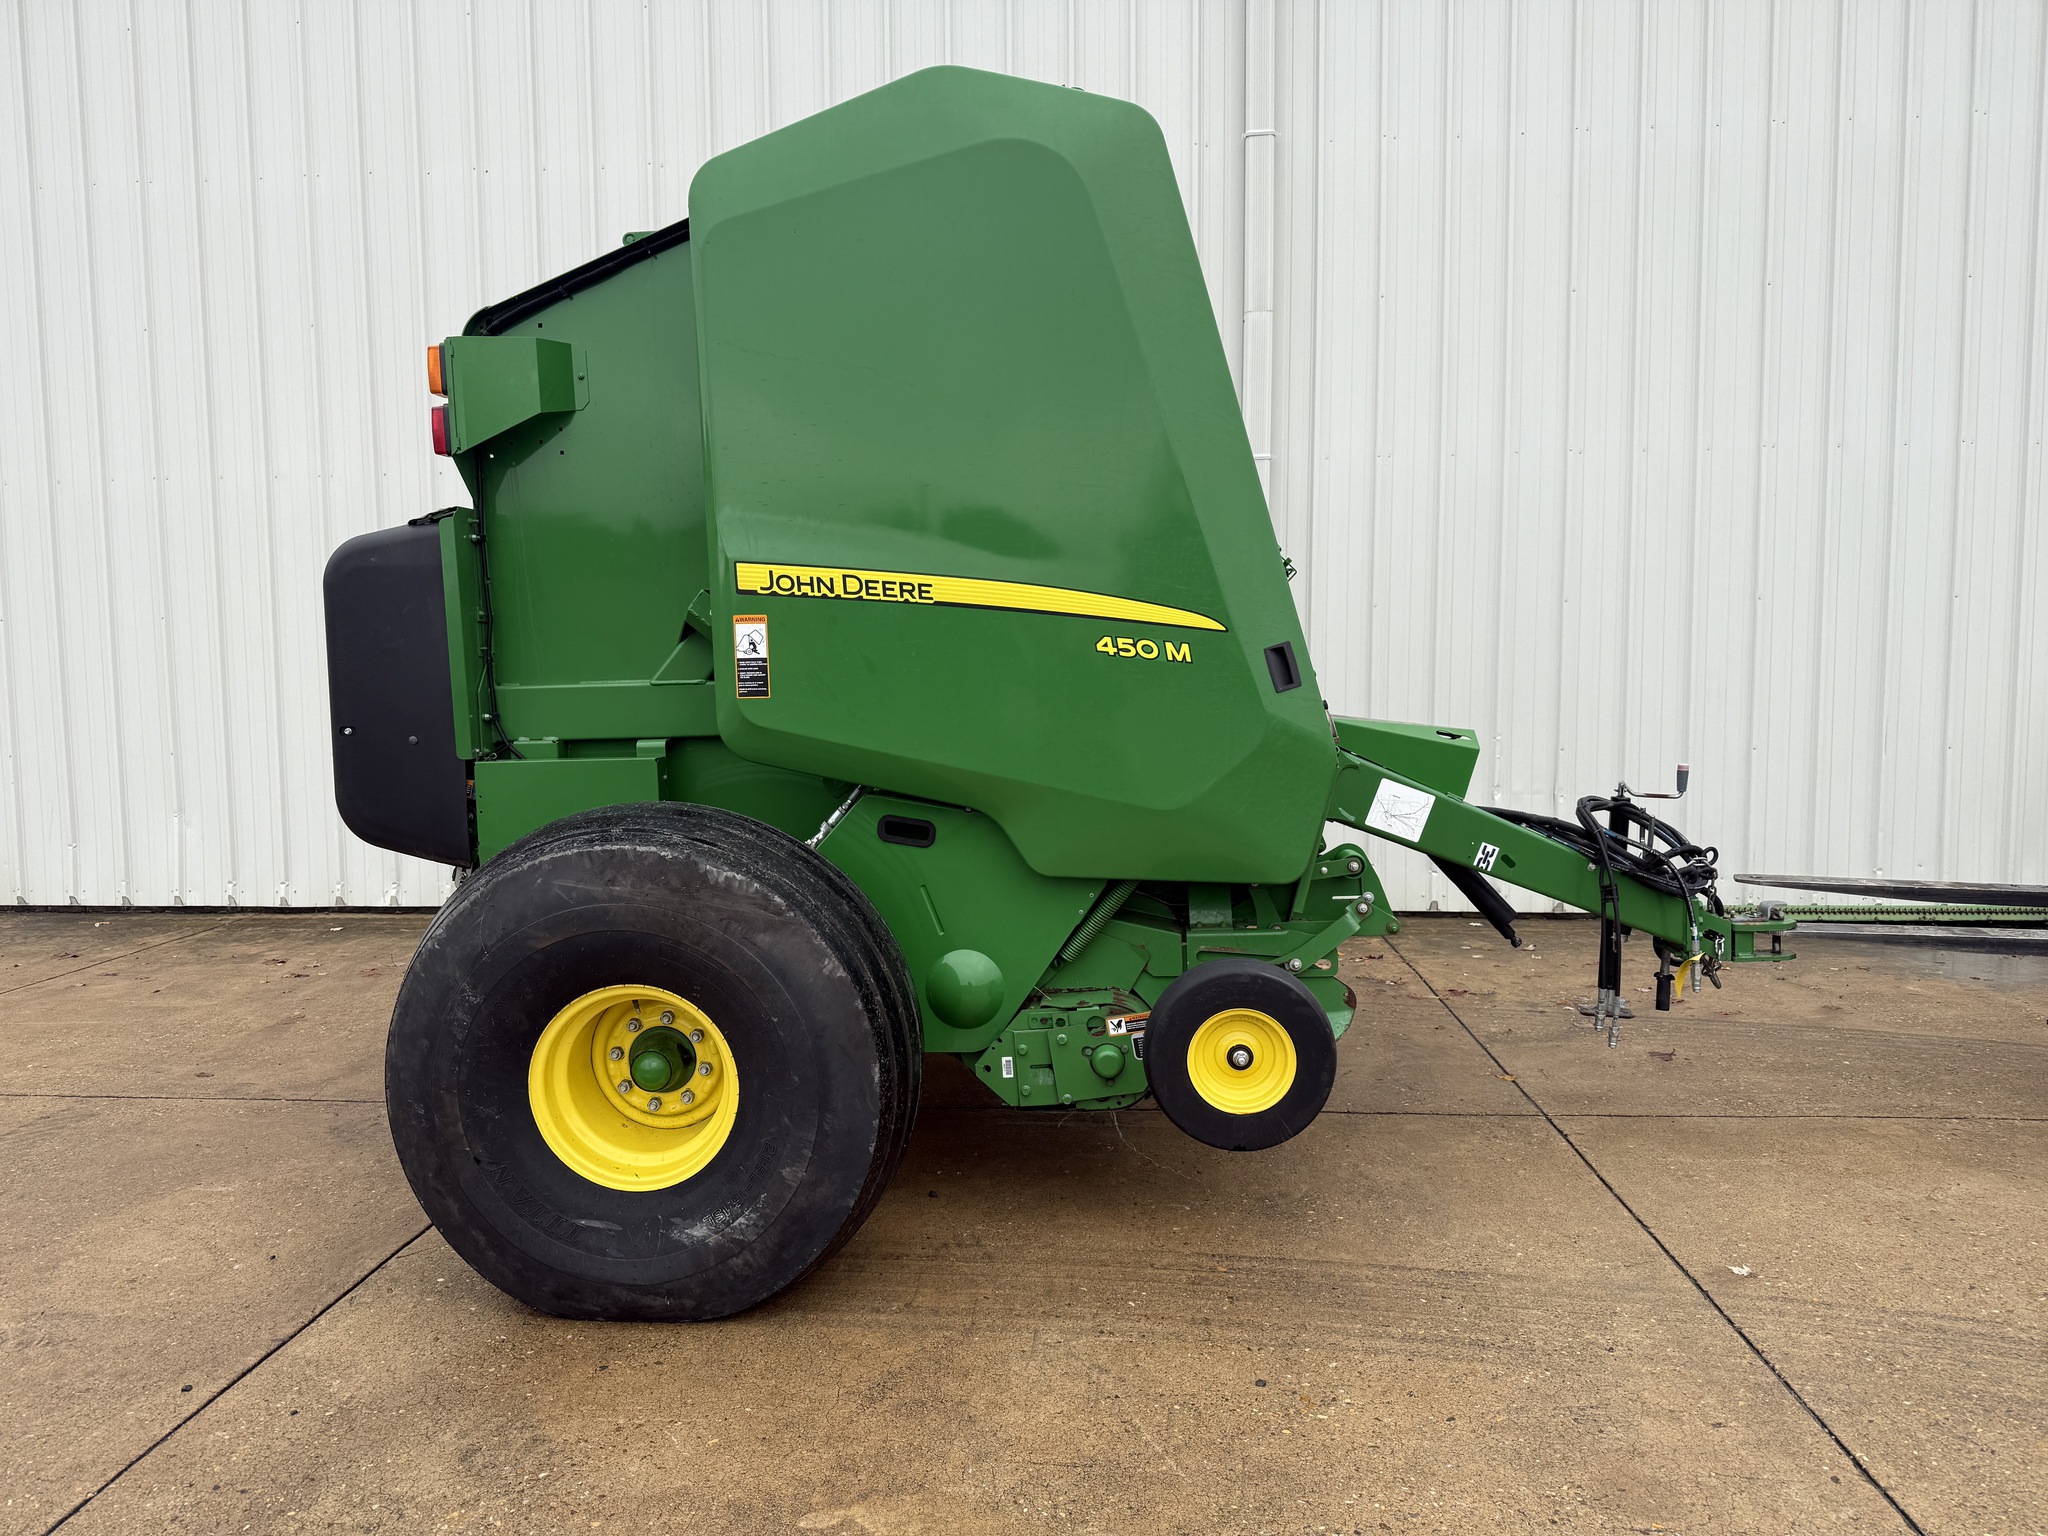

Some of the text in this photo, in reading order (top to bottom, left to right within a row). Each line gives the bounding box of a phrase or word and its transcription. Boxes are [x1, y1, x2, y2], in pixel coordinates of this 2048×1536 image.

[760, 570, 933, 600] JOHN DEERE
[1095, 635, 1194, 664] 450 M
[490, 1164, 587, 1246] TITAN
